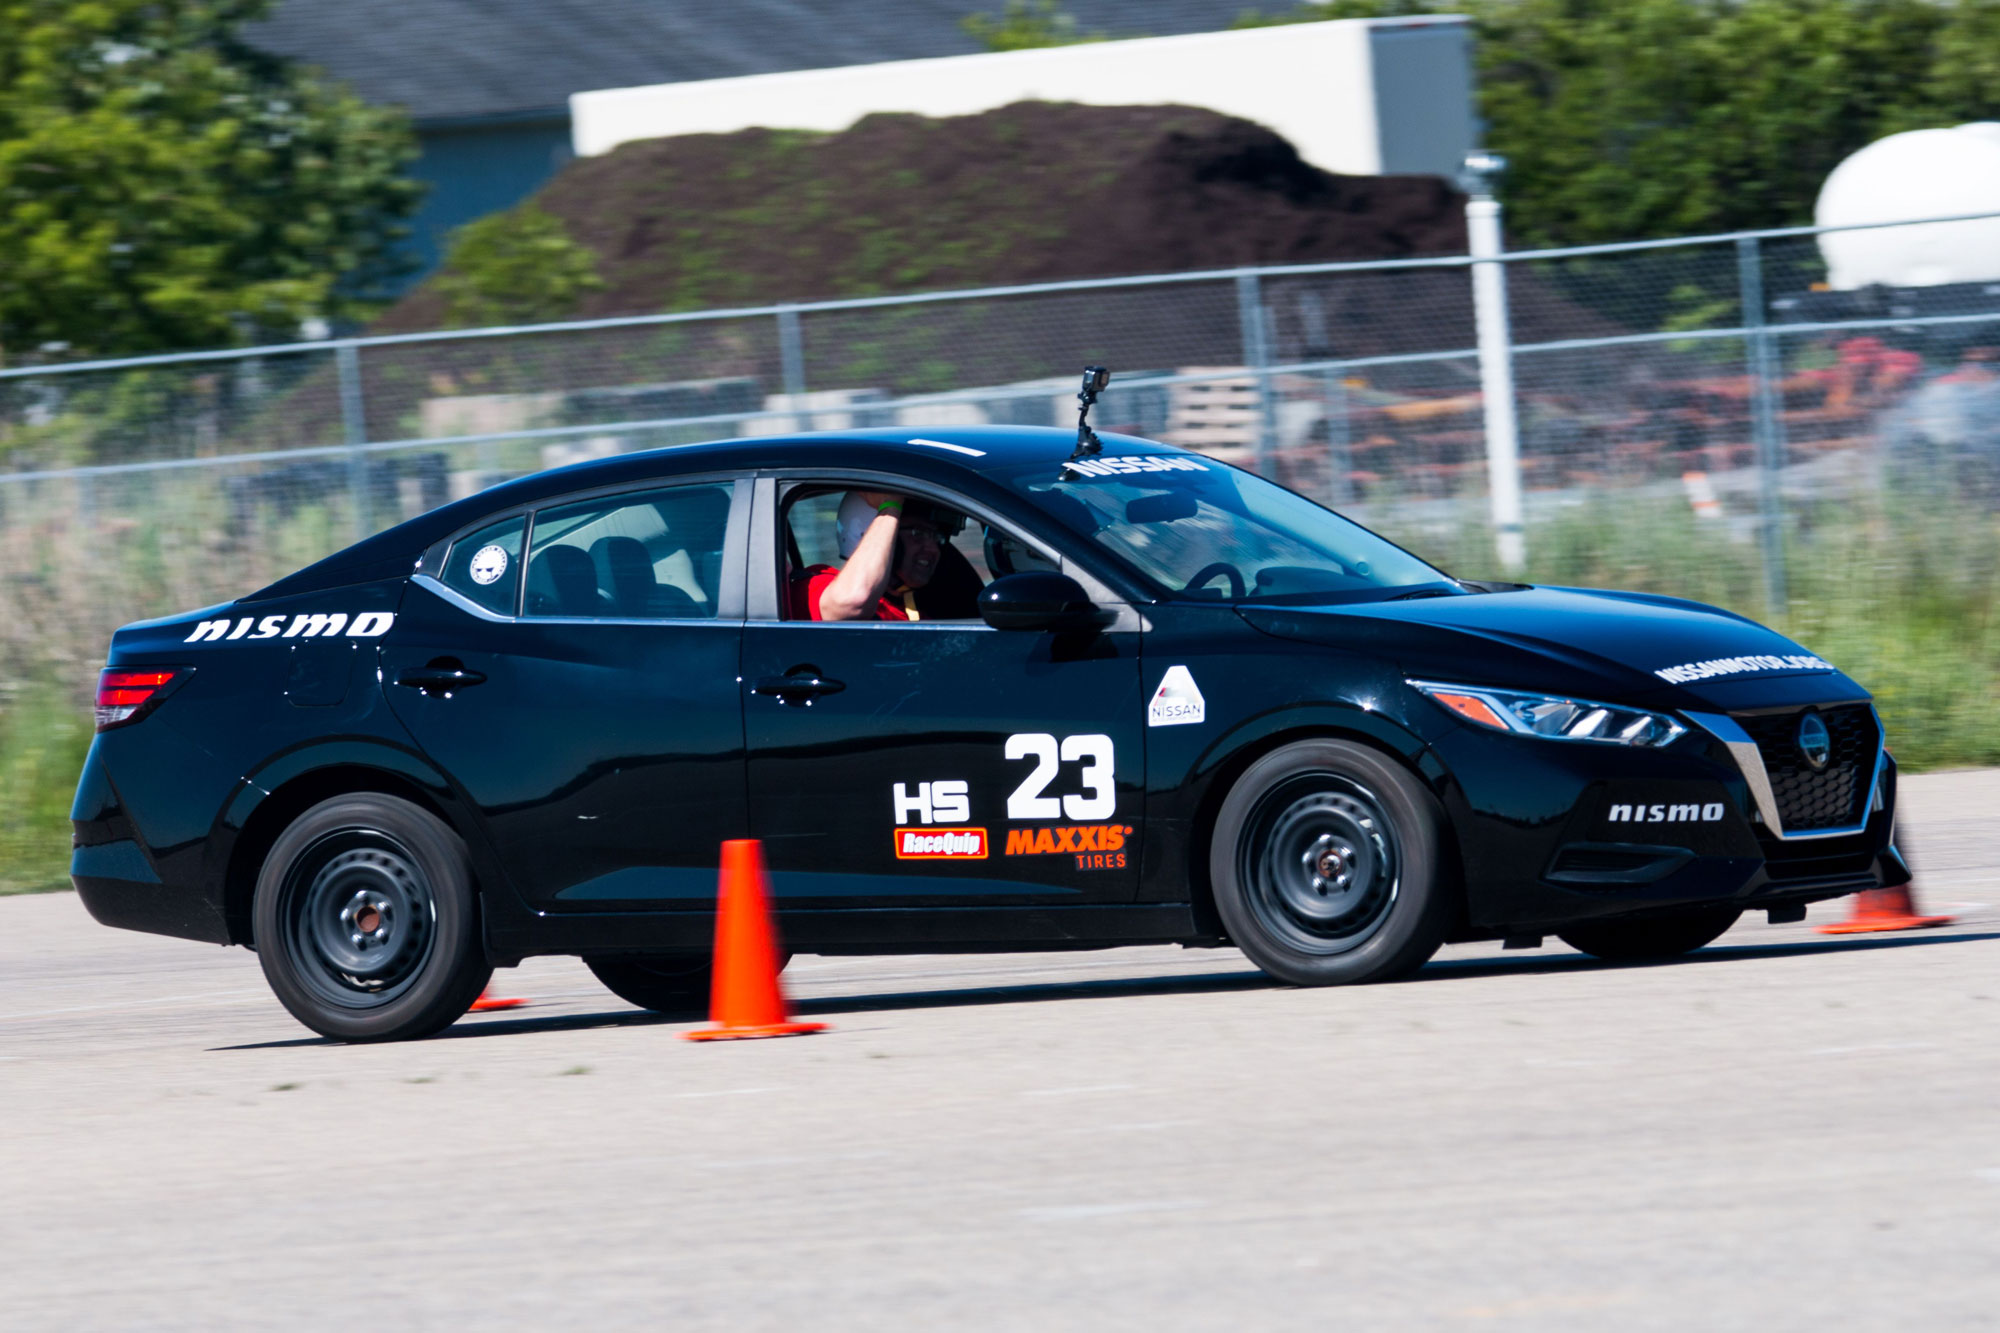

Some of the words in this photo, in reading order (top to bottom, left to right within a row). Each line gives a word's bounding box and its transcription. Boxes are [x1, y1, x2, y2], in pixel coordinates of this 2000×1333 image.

[1062, 456, 1210, 477] NISSAN
[183, 612, 394, 642] nismo
[1152, 704, 1201, 717] NISSAN
[1005, 733, 1116, 820] 23
[894, 780, 970, 824] HS
[1608, 803, 1724, 822] nismo
[903, 832, 980, 855] RaceQuip
[1076, 854, 1126, 869] TIRES
